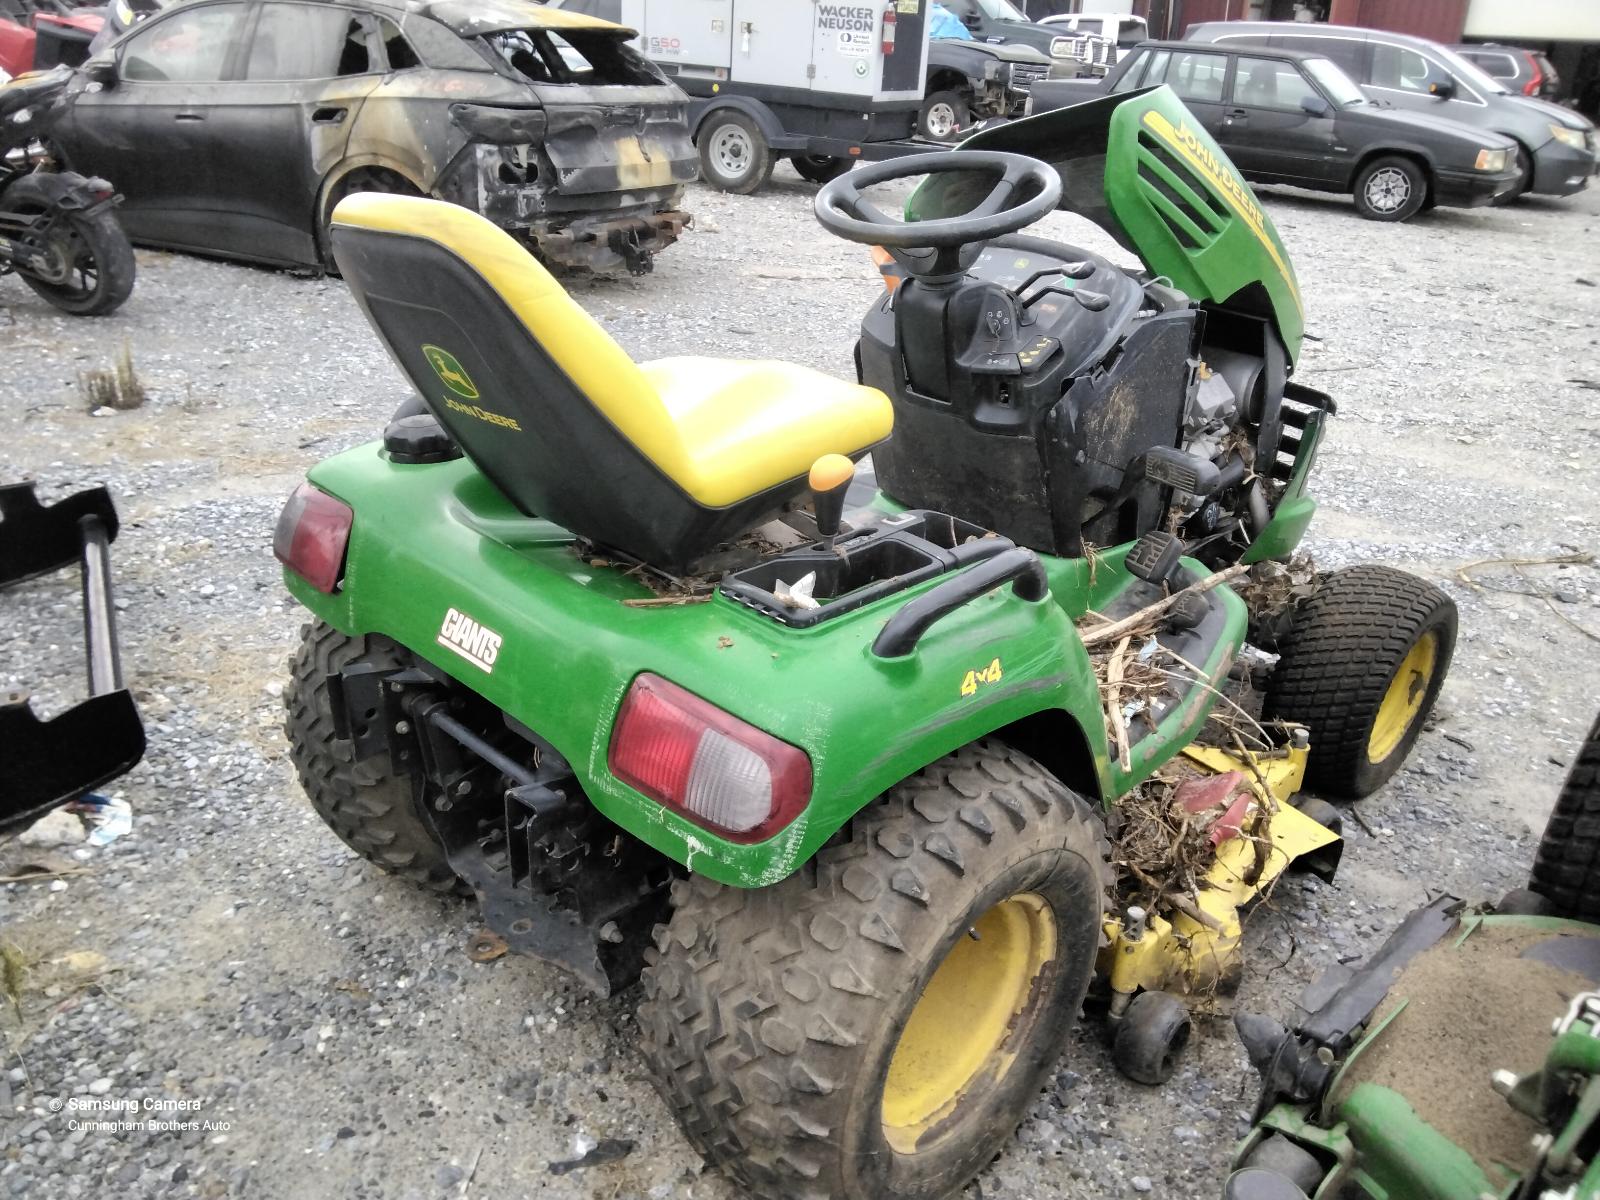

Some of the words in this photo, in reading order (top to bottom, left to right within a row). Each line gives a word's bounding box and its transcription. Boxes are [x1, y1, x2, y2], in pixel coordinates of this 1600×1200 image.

[818, 4, 873, 20] WACKER
[818, 17, 873, 32] NEUSON
[1174, 118, 1221, 177] JOHN
[1221, 165, 1265, 229] DEERE
[443, 395, 478, 417] JOHN
[472, 405, 522, 431] DEERE
[440, 607, 502, 665] GIANTS
